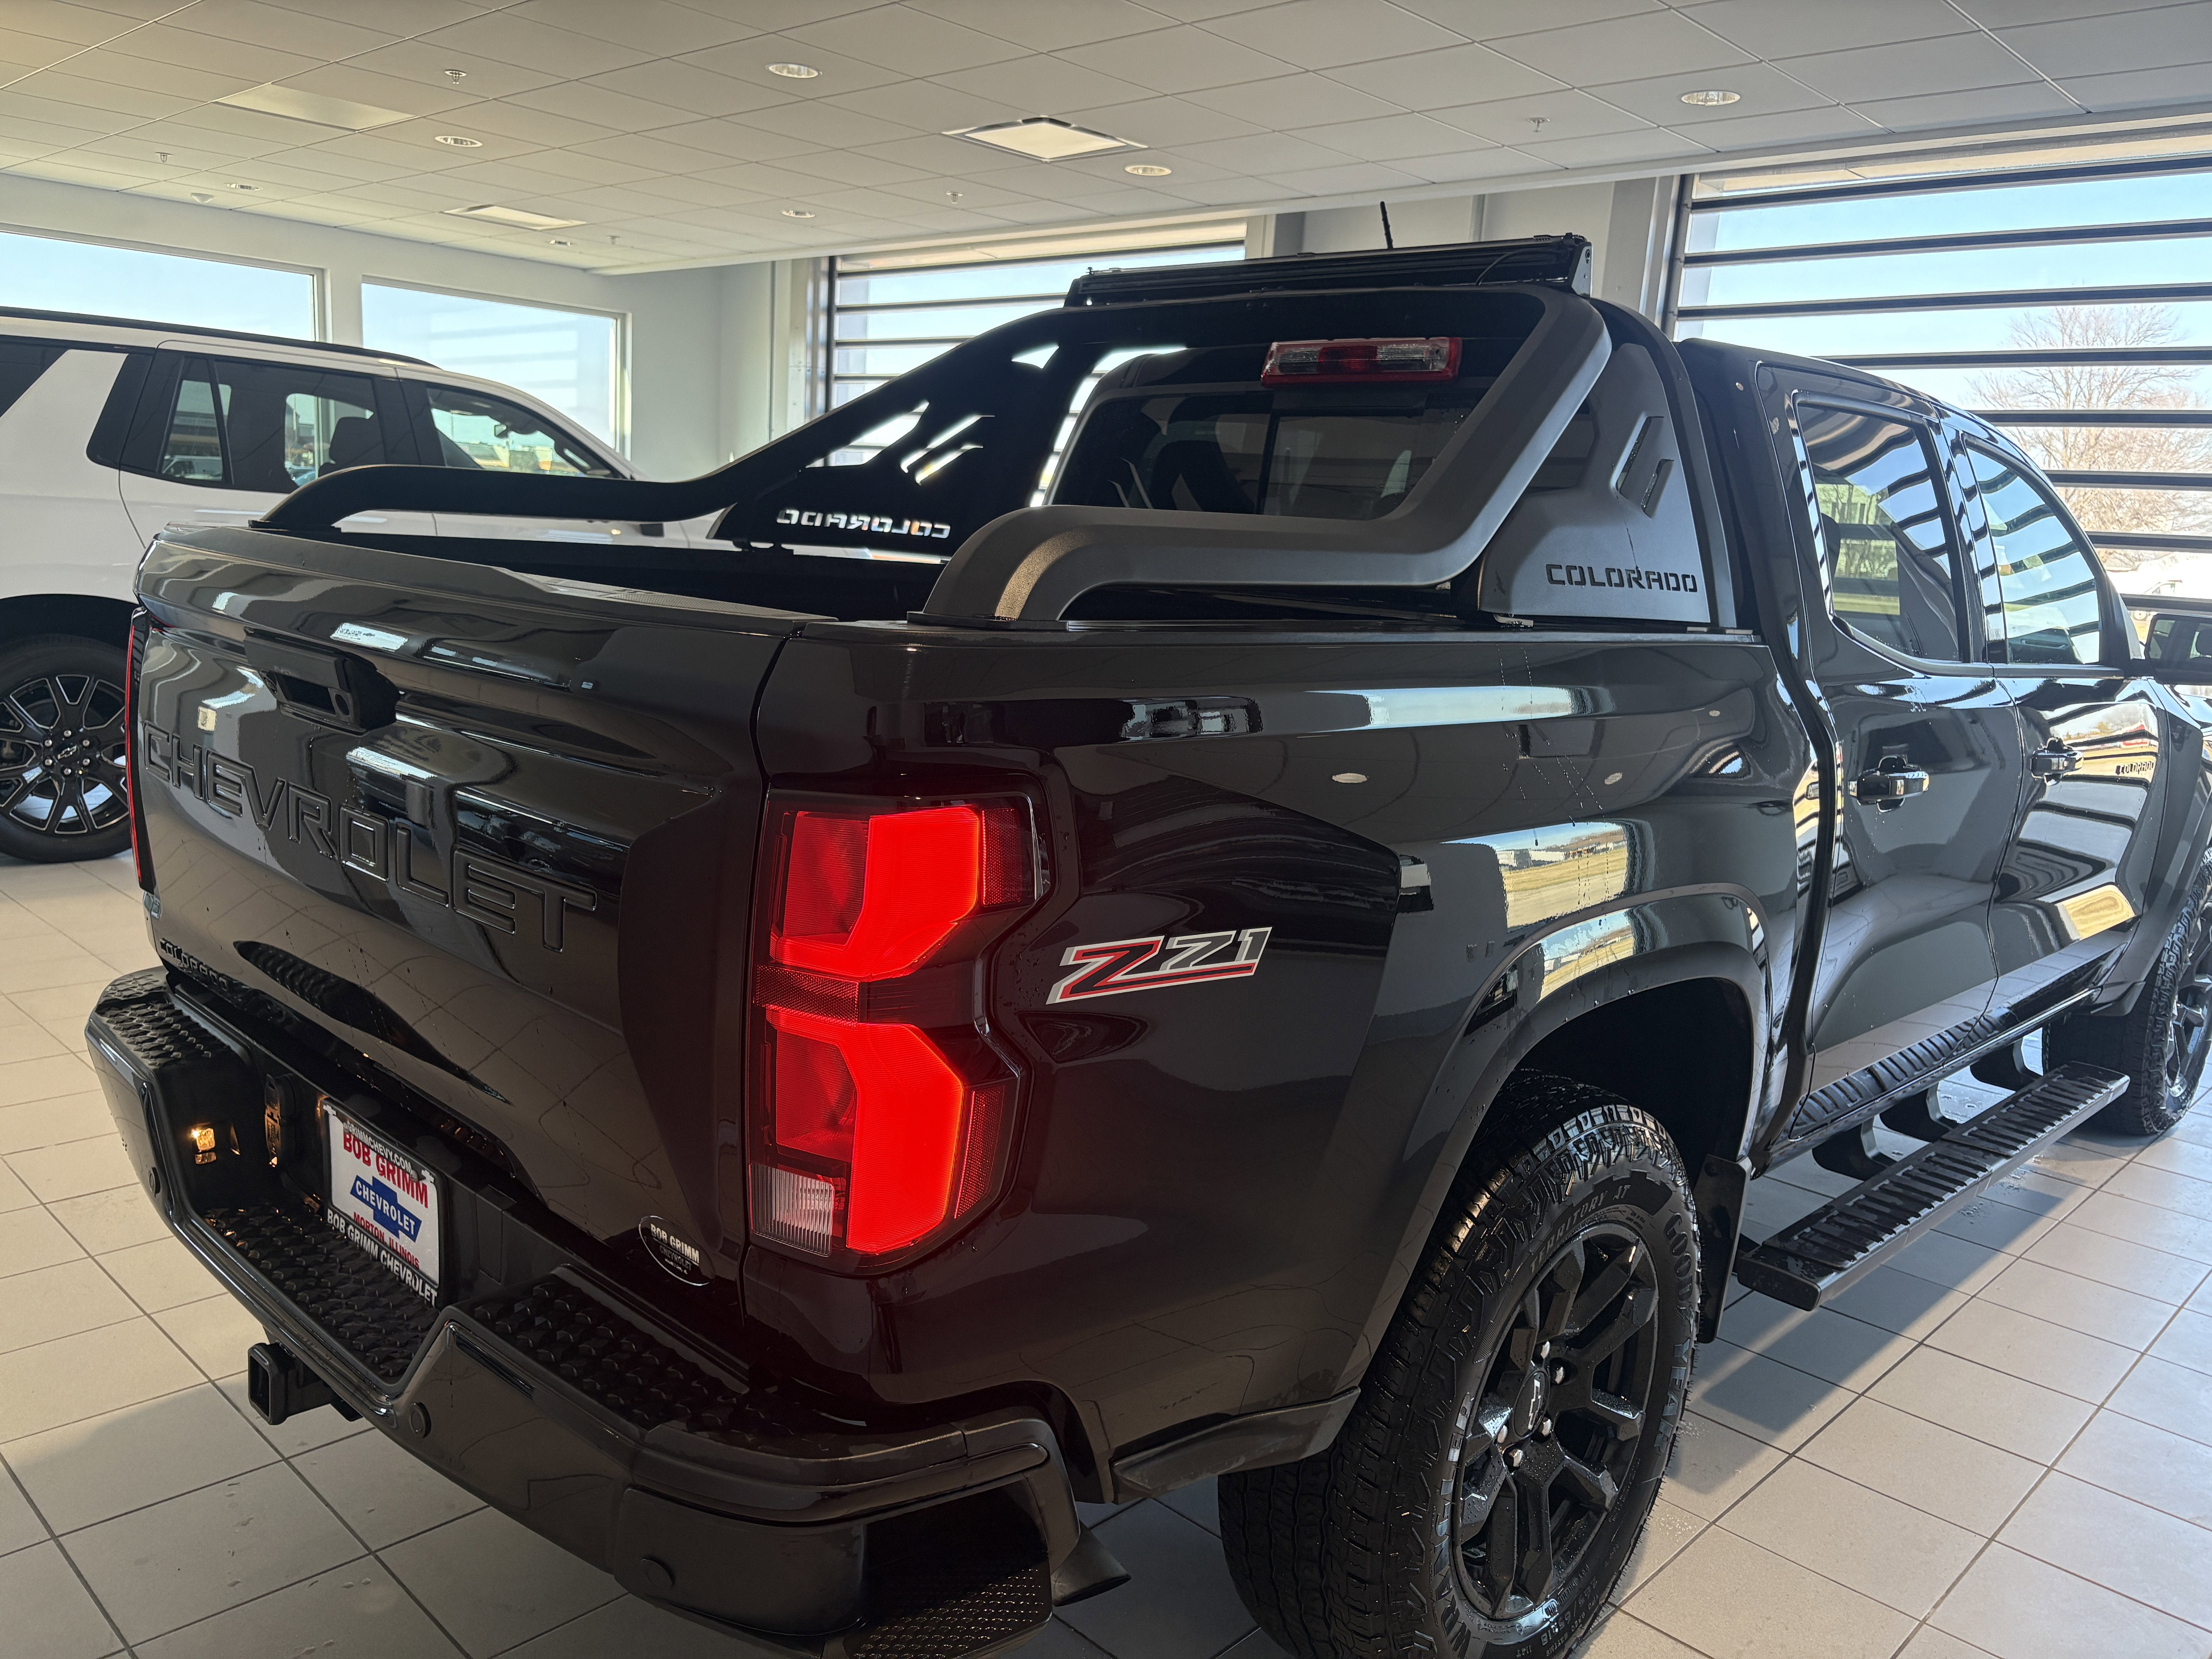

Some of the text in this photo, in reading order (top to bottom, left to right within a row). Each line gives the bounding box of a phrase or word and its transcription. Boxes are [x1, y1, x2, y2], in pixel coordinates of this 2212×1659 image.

[1546, 564, 1698, 592] COLORADO
[2120, 761, 2154, 774] COLORADO
[144, 720, 597, 953] CHEVROLET
[1046, 927, 1273, 1005] Z71
[343, 1133, 428, 1208] BOB GRIMM
[347, 1120, 412, 1173] GRIMMCHEVY.COM
[354, 1212, 419, 1269] MORTON, ILLINOIS
[356, 1180, 416, 1236] CHEVROLET
[1530, 1190, 1608, 1274] TERRITORY
[328, 1209, 437, 1309] BOB GRIMM CHEVROLET
[651, 1223, 700, 1264] BOB GRIMM
[659, 1245, 692, 1271] CHEVROLET
[1654, 1213, 1693, 1450] GOODYEAR
[1434, 1392, 1472, 1659] WRANGLER
